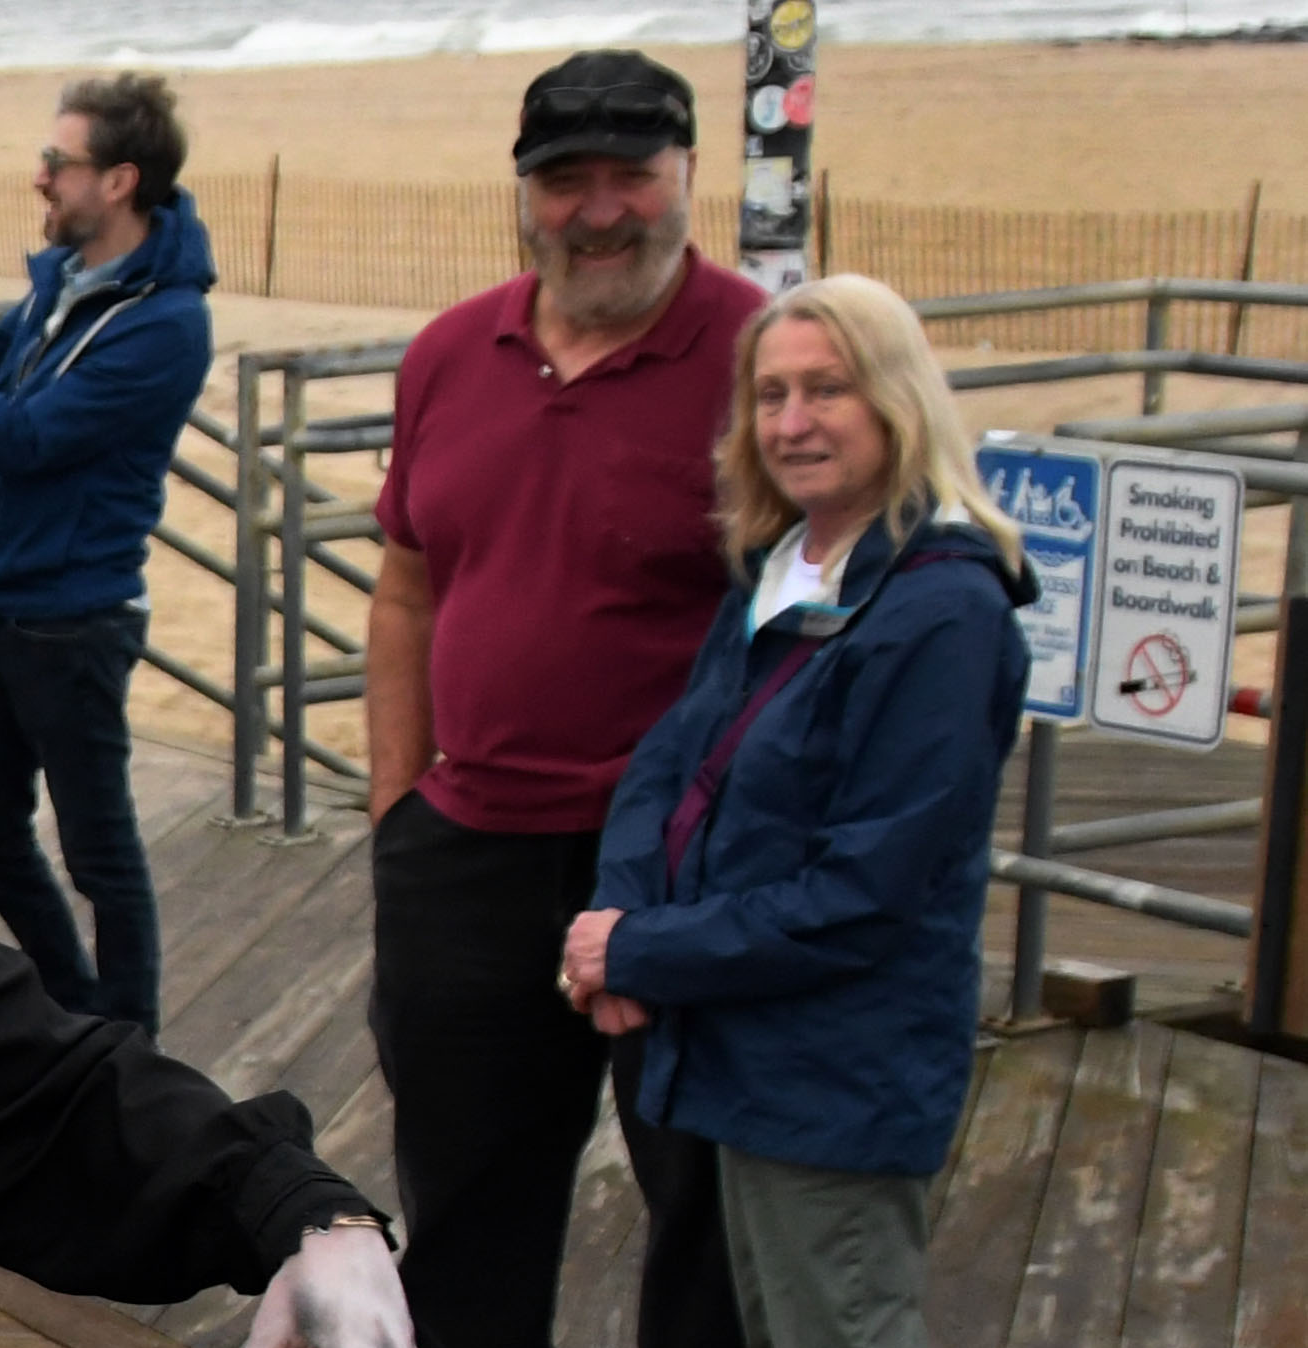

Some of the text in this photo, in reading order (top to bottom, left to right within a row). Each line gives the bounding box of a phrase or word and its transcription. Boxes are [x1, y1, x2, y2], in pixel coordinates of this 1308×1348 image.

[1129, 482, 1215, 520] Smoking
[1121, 517, 1220, 549] Prohibited
[1114, 555, 1222, 585] on Beach &
[1112, 586, 1219, 620] Boardwalk
